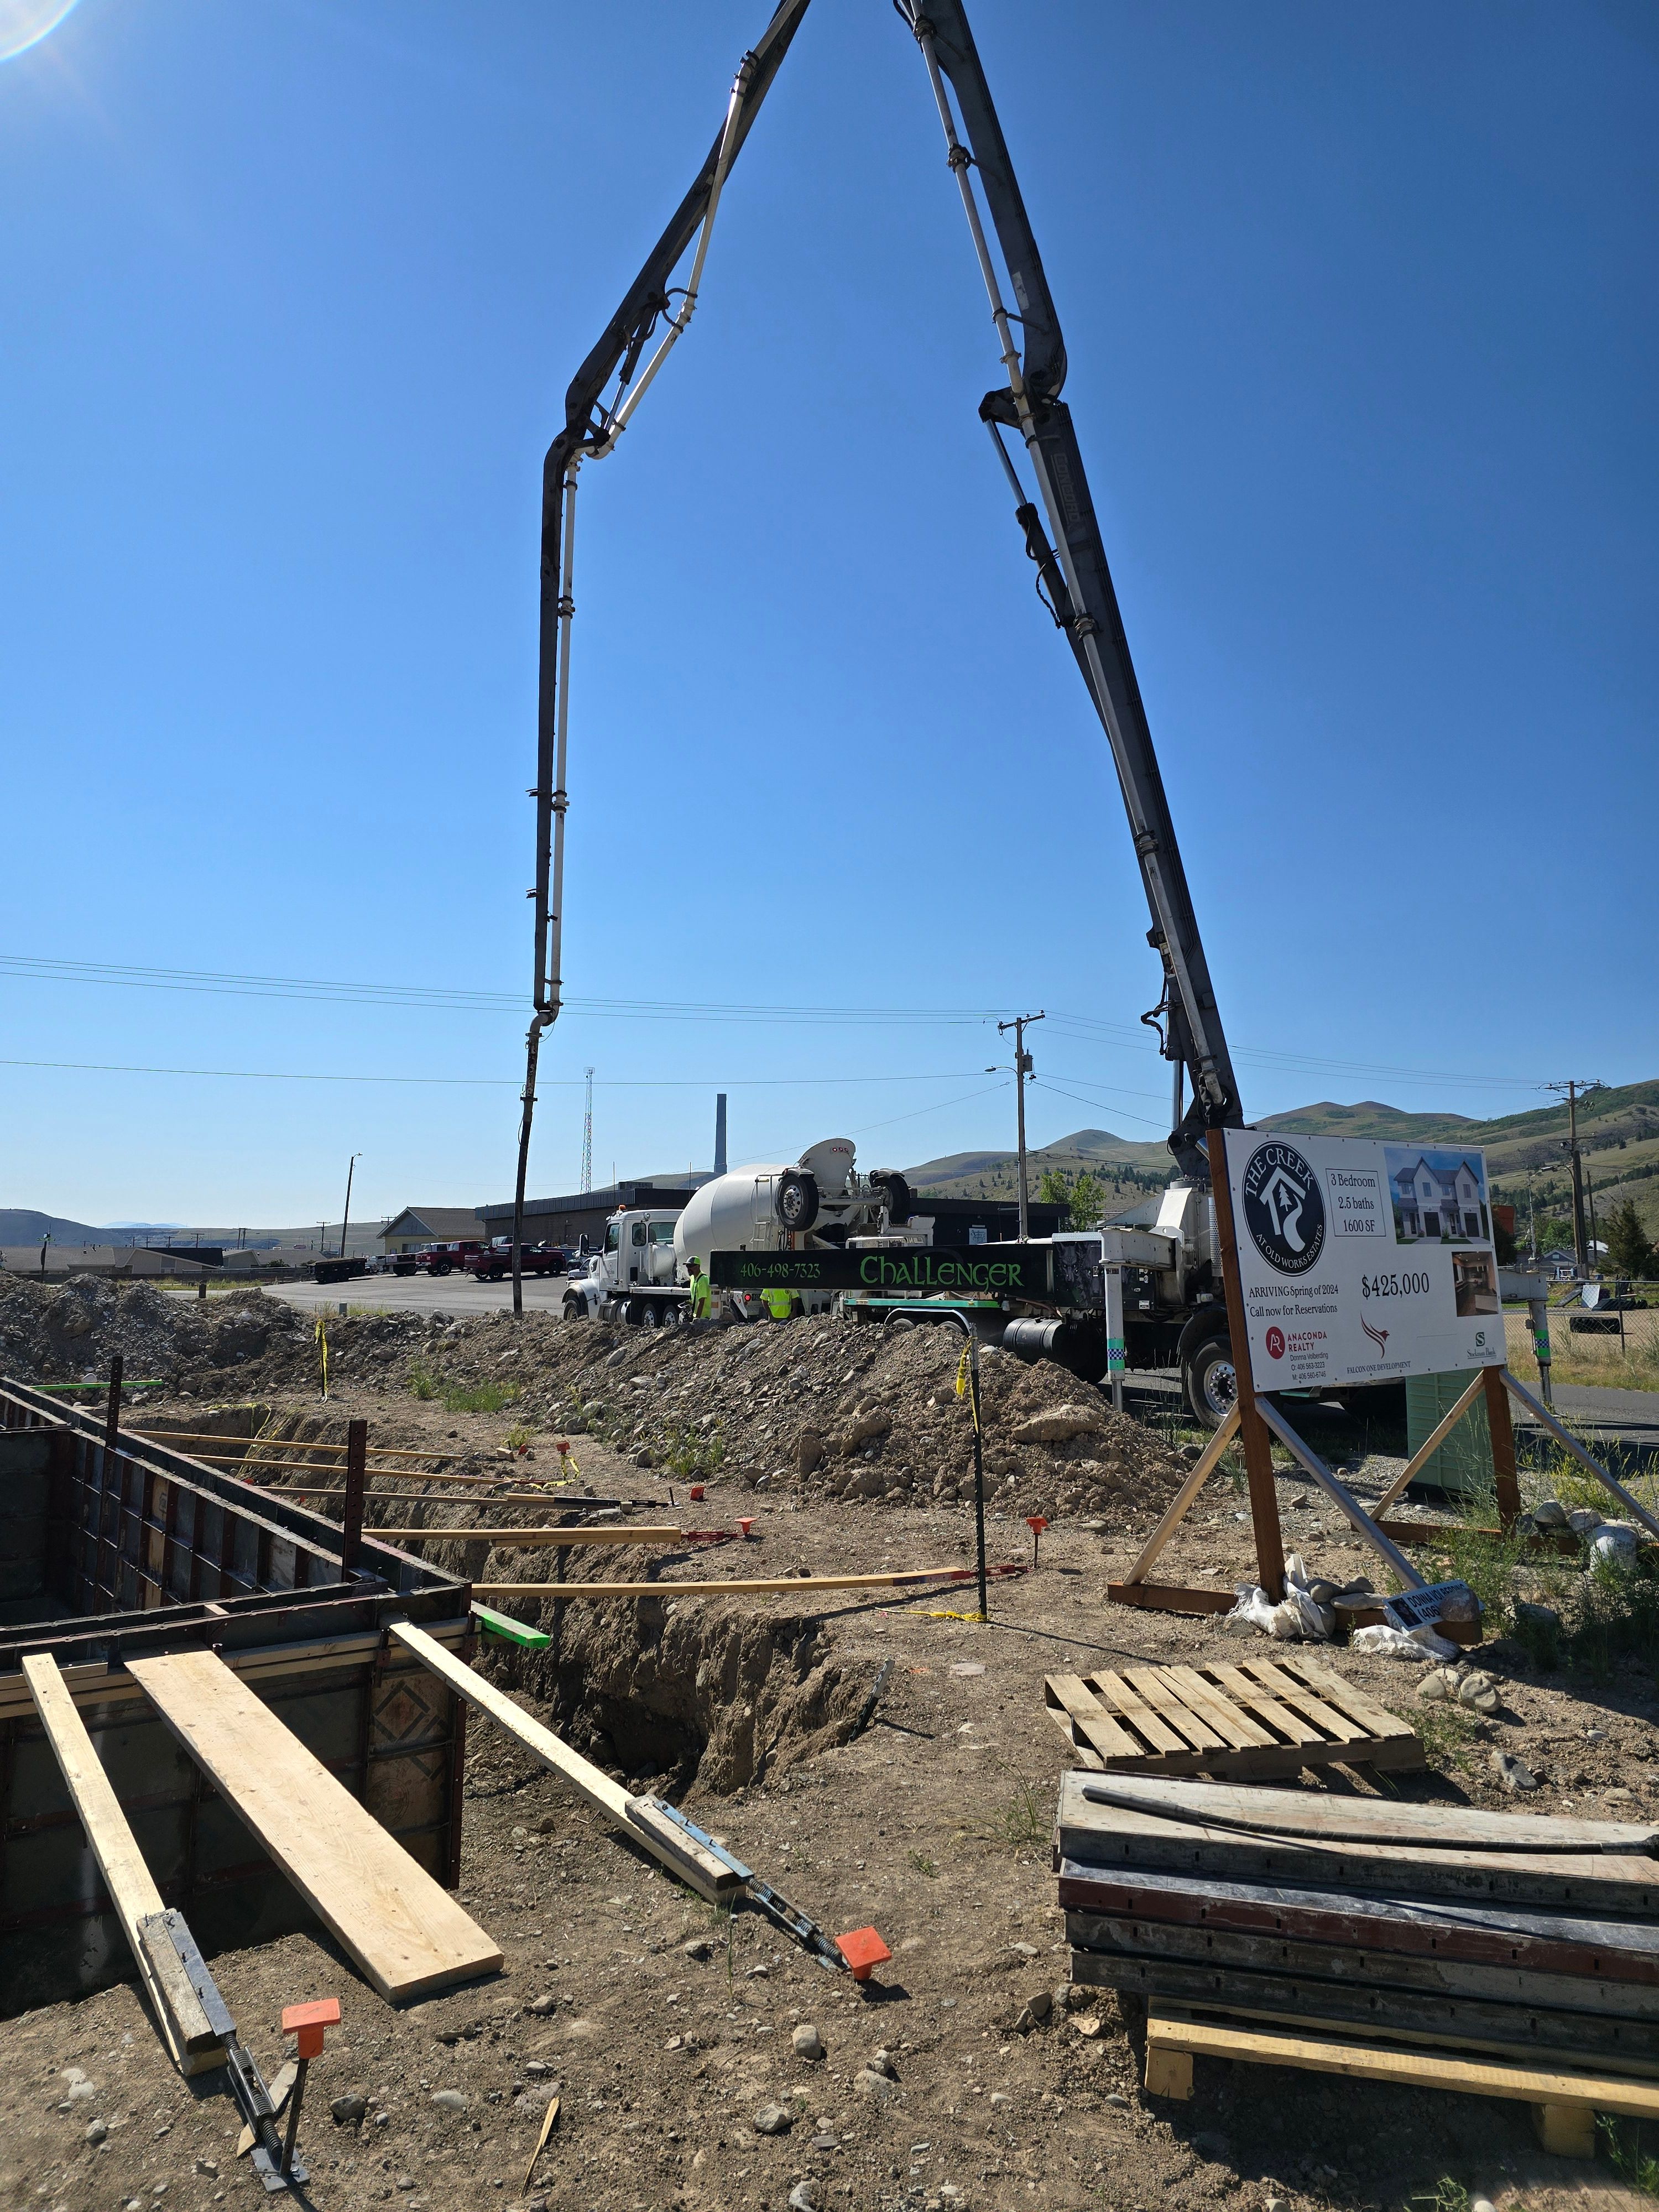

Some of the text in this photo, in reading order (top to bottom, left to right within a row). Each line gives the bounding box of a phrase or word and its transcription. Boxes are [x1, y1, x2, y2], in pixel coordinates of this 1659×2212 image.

[1246, 1147, 1314, 1197] THE CREEK
[1331, 1173, 1376, 1187] 3 Bedroom
[1338, 1196, 1374, 1209] 2.5 baths
[1344, 1219, 1375, 1232] 1600 SF
[1256, 1224, 1323, 1269] AT OLD WORKS ESTATES
[740, 1262, 821, 1279] 406-498-7323
[1314, 1285, 1322, 1295] of
[1322, 1284, 1339, 1295] 2024
[1361, 1272, 1430, 1300] $425,000
[1250, 1303, 1338, 1317] Call now for Reservations
[1287, 1331, 1328, 1342] ANACONDA
[1288, 1342, 1314, 1352] REALTY
[1347, 1360, 1411, 1374] FALCON ONE DEVELOPMENT
[1407, 1593, 1434, 1608] DONNA
